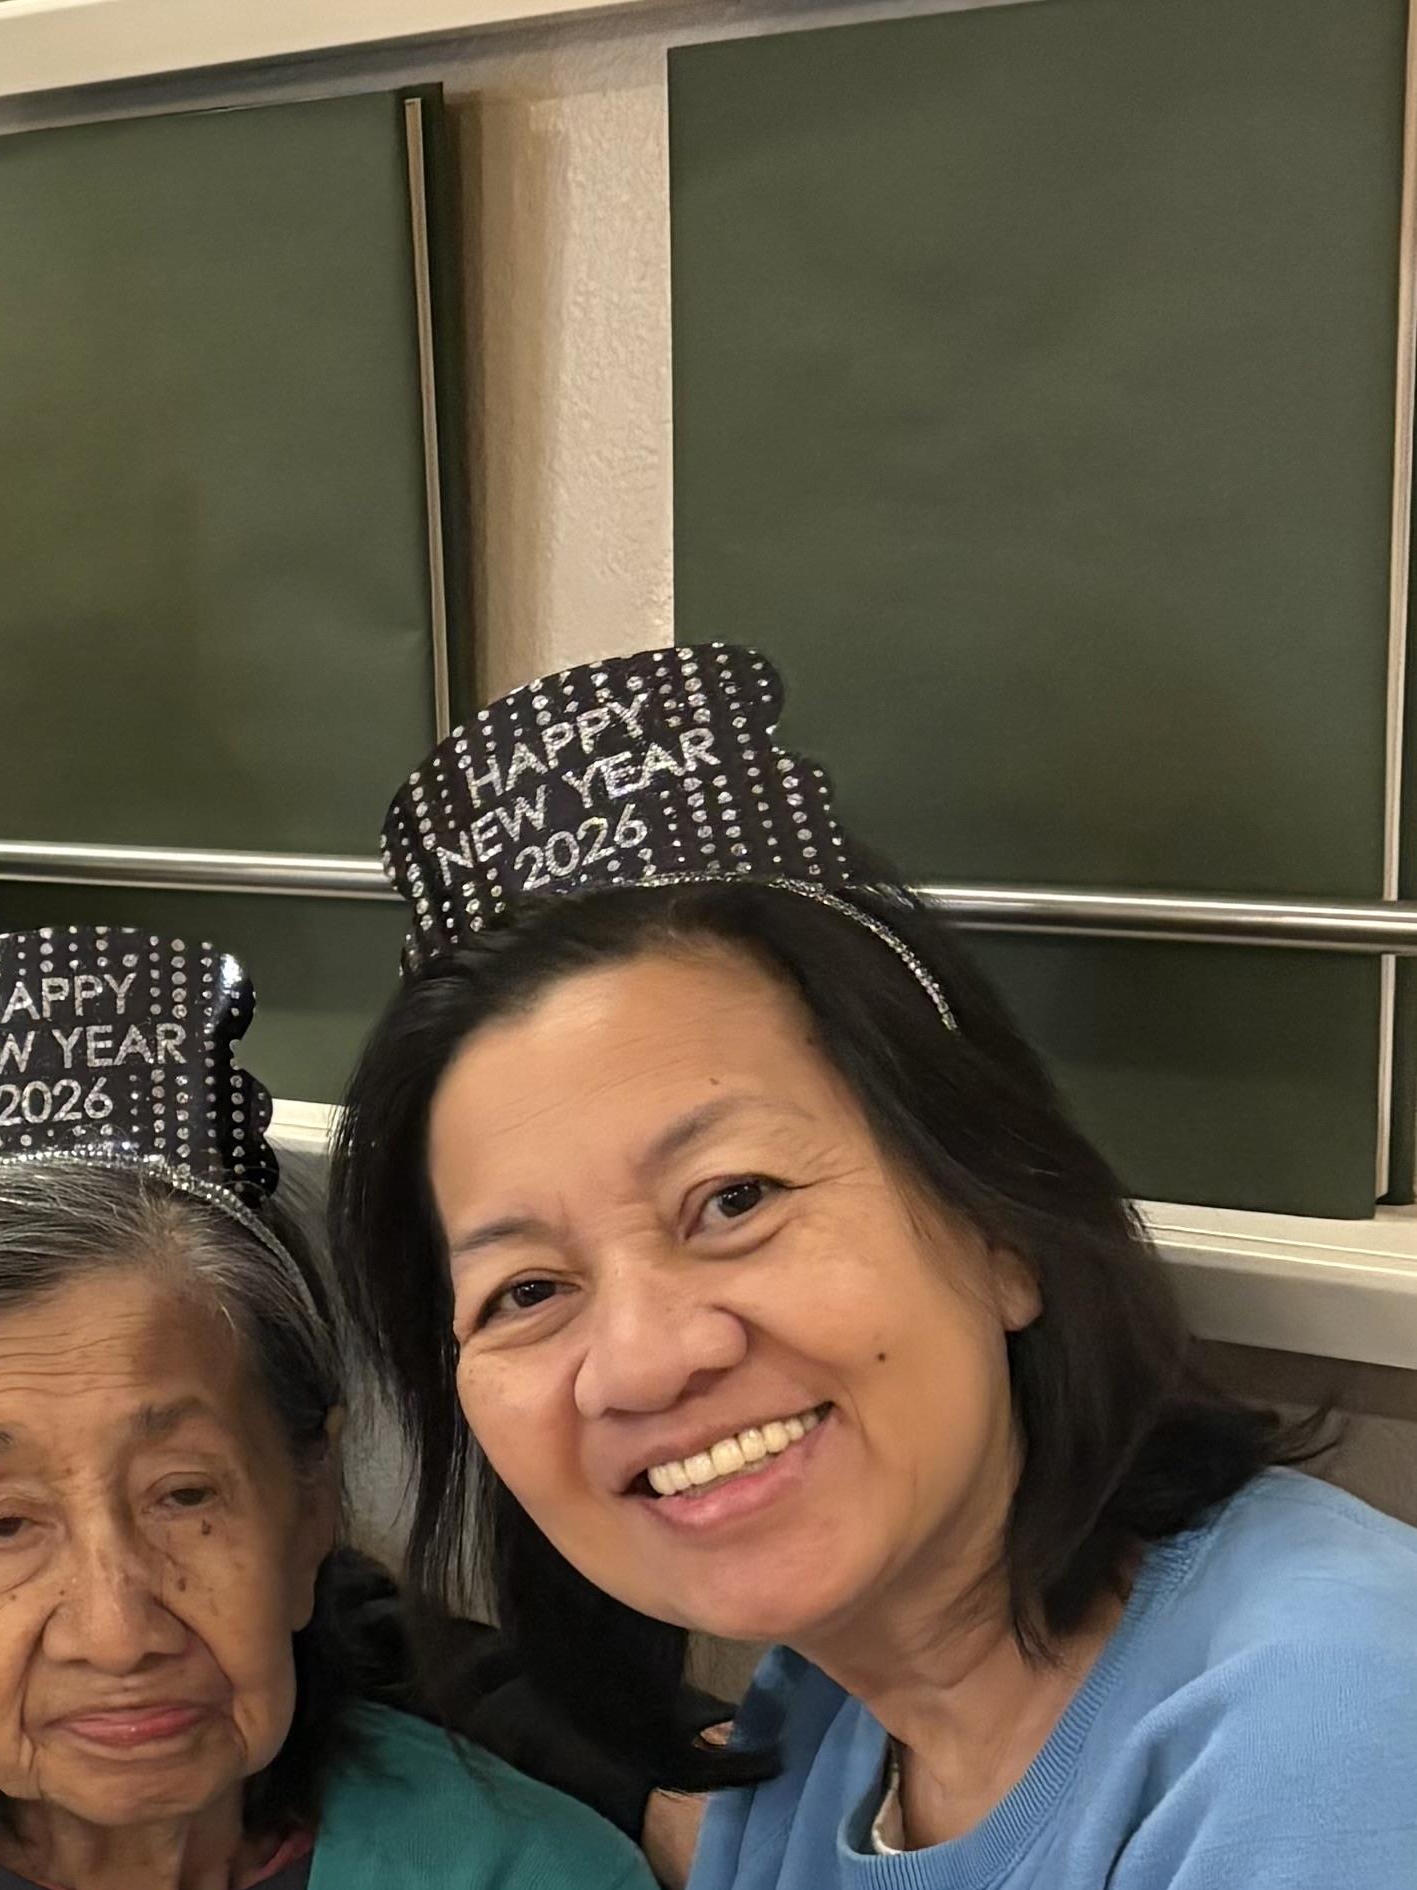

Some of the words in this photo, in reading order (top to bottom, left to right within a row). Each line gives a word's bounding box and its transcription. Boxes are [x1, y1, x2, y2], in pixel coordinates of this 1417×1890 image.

[465, 693, 648, 808] HAPPY
[436, 784, 548, 887] NEW
[562, 727, 721, 809] YEAR
[514, 804, 647, 890] 2026
[52, 1023, 186, 1069] YEAR
